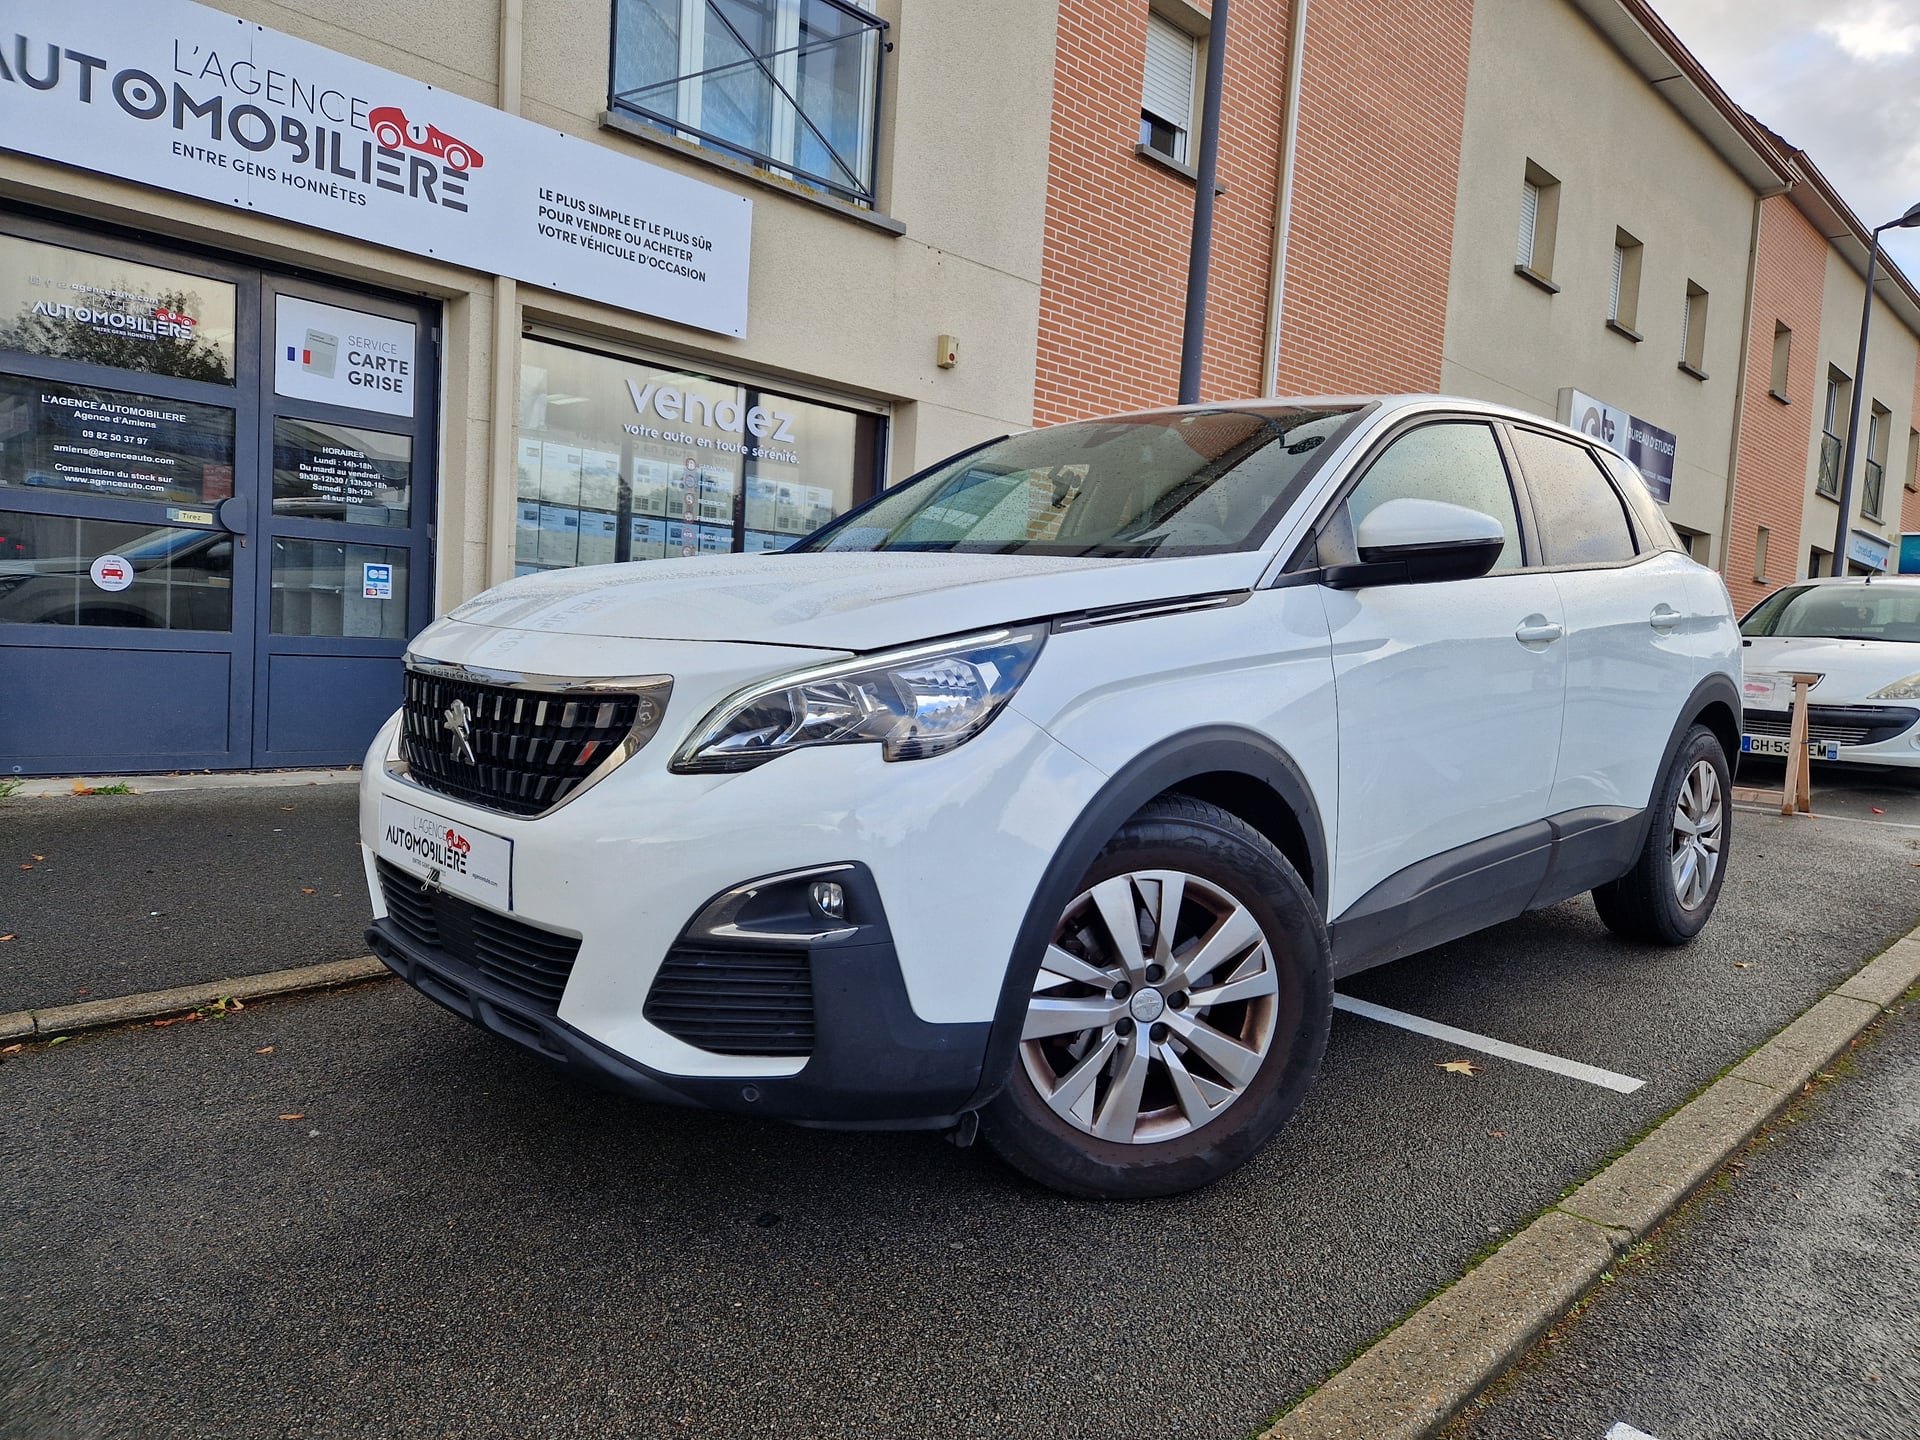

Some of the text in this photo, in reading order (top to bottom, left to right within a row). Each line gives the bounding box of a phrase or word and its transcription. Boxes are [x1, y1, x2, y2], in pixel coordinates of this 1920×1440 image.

[174, 38, 370, 132] L'AGENCE
[172, 141, 367, 207] ENTRE GENS HONNÊTES
[539, 187, 713, 252] LE PLUS SIMPLE ET LE PLUS SÛR
[538, 205, 693, 262] POUR VENDRE OU ACHETER
[538, 223, 706, 282] VOTRE VÉHICULE D'OCCASION
[348, 335, 398, 355] SERVICE
[348, 351, 409, 376] CARTE
[348, 370, 403, 394] GRISE
[41, 394, 187, 423] L'AGENCE AUTOMOBILIERE
[74, 410, 156, 429] Agence d'Amiens
[625, 378, 796, 444] vendez
[82, 429, 149, 446] 09 82 50 37 97
[623, 423, 659, 439] votre
[663, 431, 693, 445] auto
[697, 437, 712, 448] en
[715, 438, 748, 455] toute
[1628, 426, 1649, 447] BUREAU
[53, 443, 175, 466] amiens@agenceauto.com
[313, 456, 336, 465] Lundi
[322, 446, 365, 459] HORAIRES
[54, 463, 173, 483] Consultation du stock sur
[64, 475, 165, 492] www.agenceauto.com
[313, 465, 335, 474] mardi
[348, 470, 381, 480] vendredi
[312, 483, 341, 493] Samedi
[346, 496, 364, 504] RDV
[182, 512, 201, 521] Tirez
[413, 815, 447, 841] L'AGENCE
[386, 824, 467, 875] AUTOMOBILIERE
